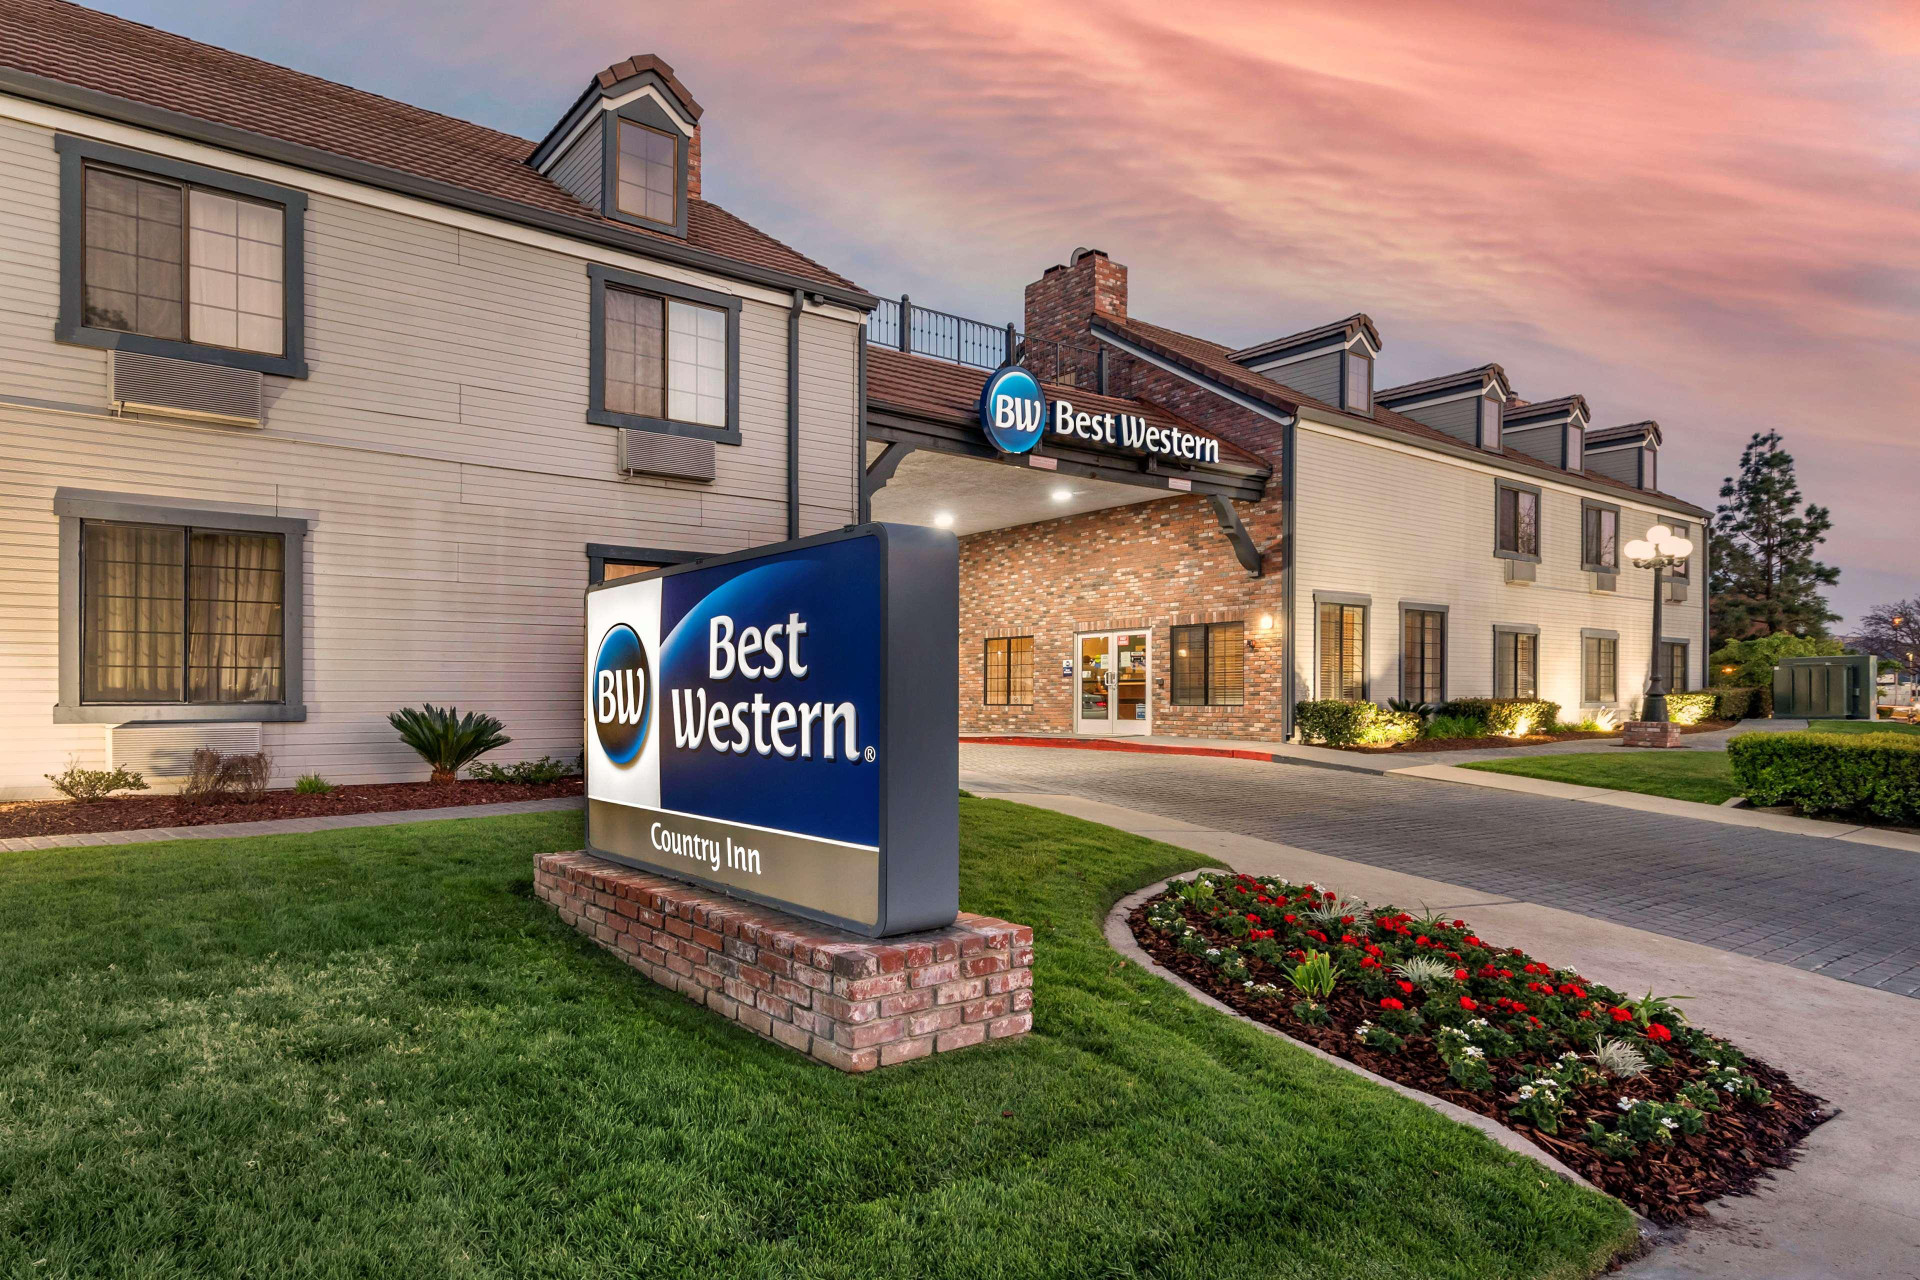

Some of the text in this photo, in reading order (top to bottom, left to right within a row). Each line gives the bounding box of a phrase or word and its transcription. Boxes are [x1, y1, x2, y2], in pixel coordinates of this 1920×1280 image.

[994, 394, 1041, 432] BW
[1055, 400, 1220, 464] Best Western
[709, 612, 808, 679] Best
[598, 668, 645, 724] BW
[671, 687, 860, 761] Western
[650, 822, 762, 875] Country Inn
